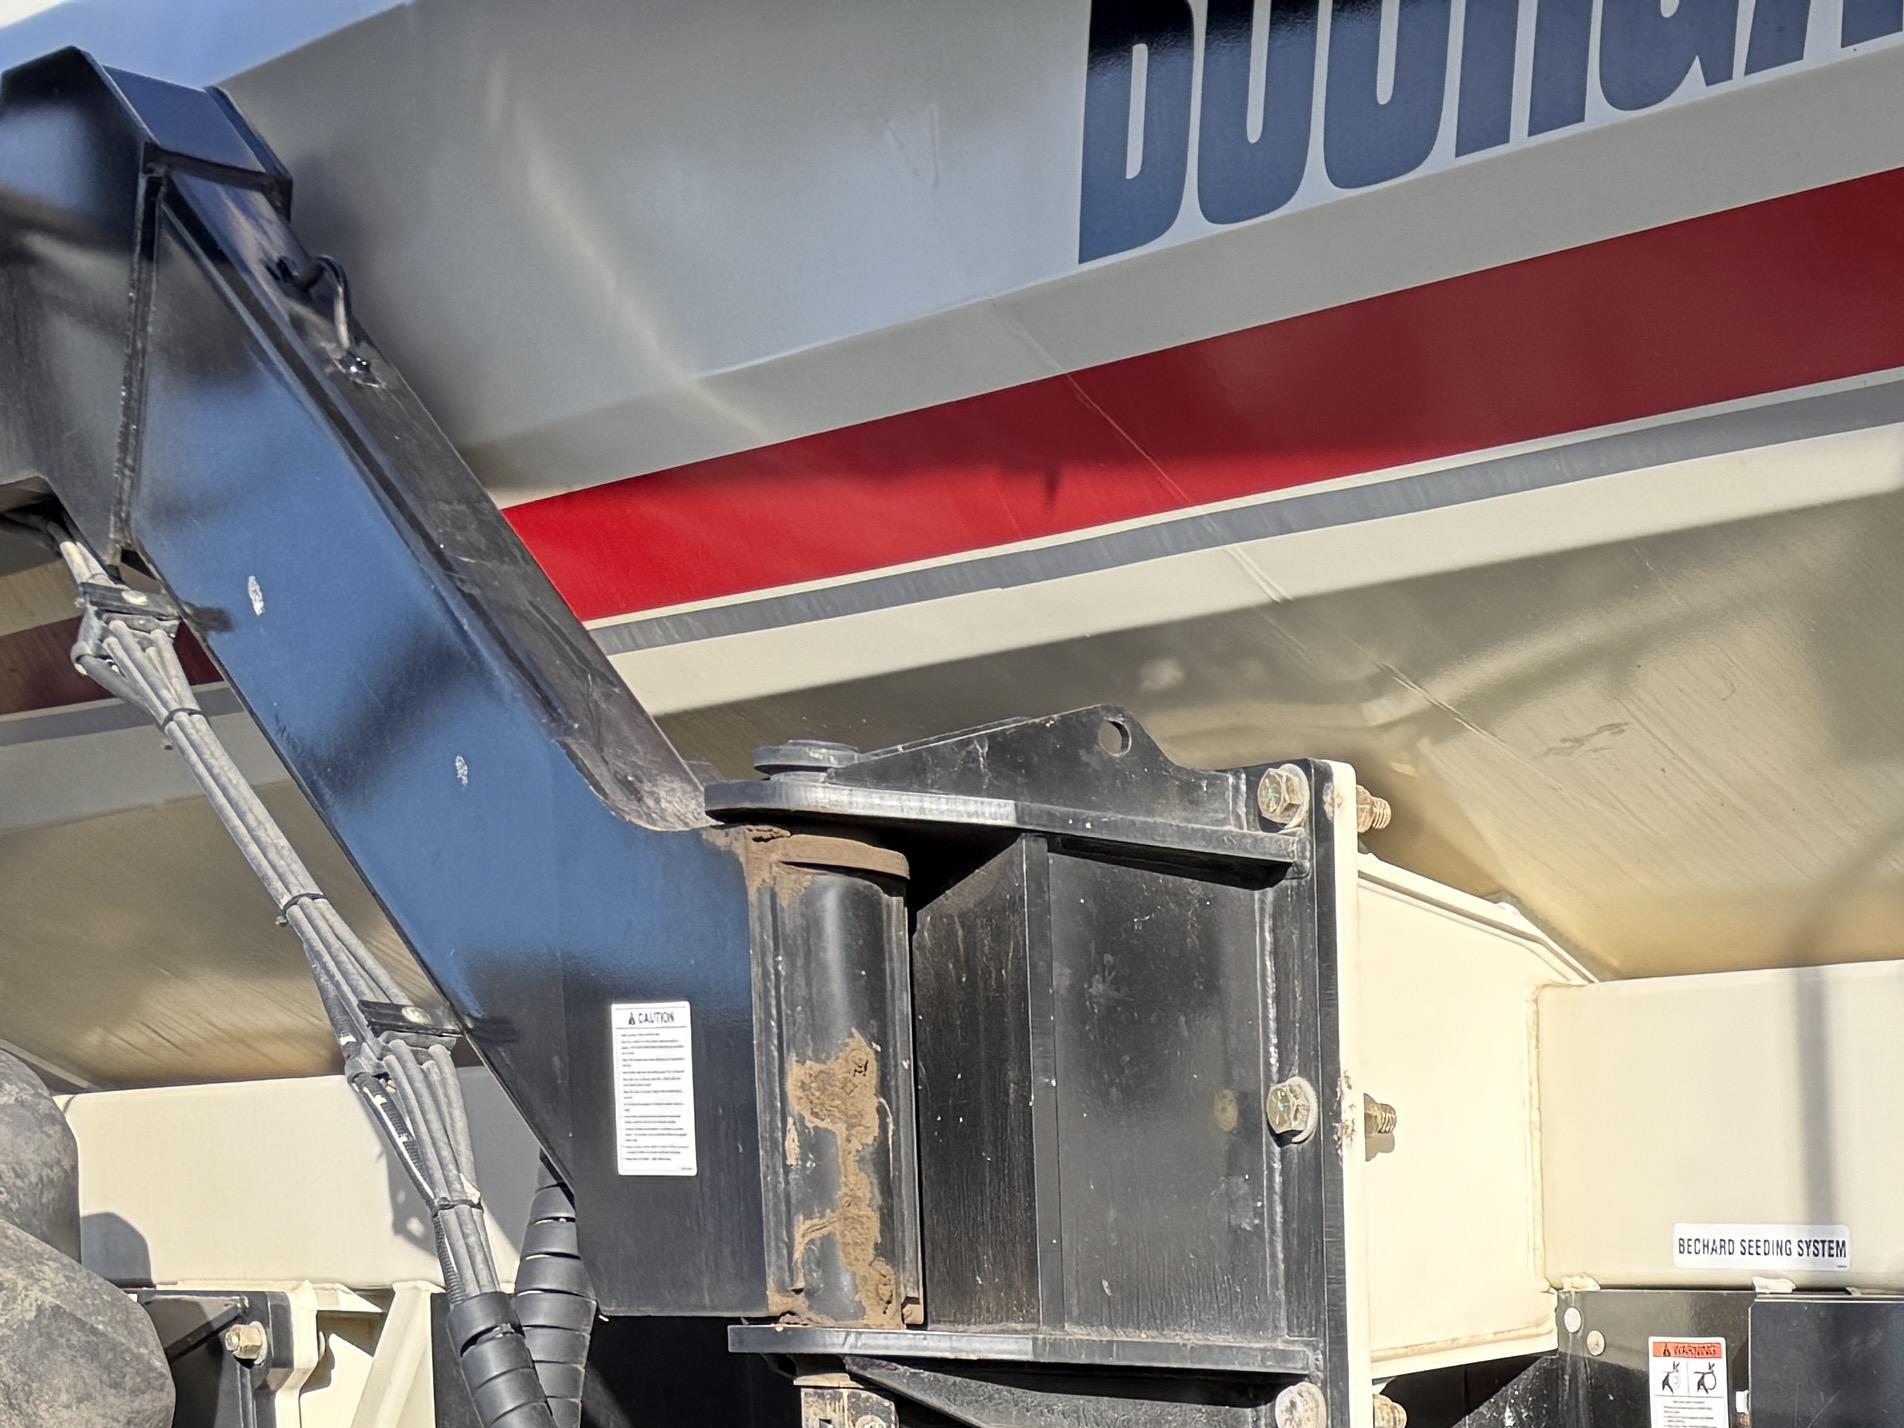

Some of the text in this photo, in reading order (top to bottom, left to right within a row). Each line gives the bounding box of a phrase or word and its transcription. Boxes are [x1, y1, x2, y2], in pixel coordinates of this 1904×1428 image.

[638, 1012, 675, 1024] CAUTION
[1679, 1238, 1846, 1257] BECHARD SEEDING SYSTEM
